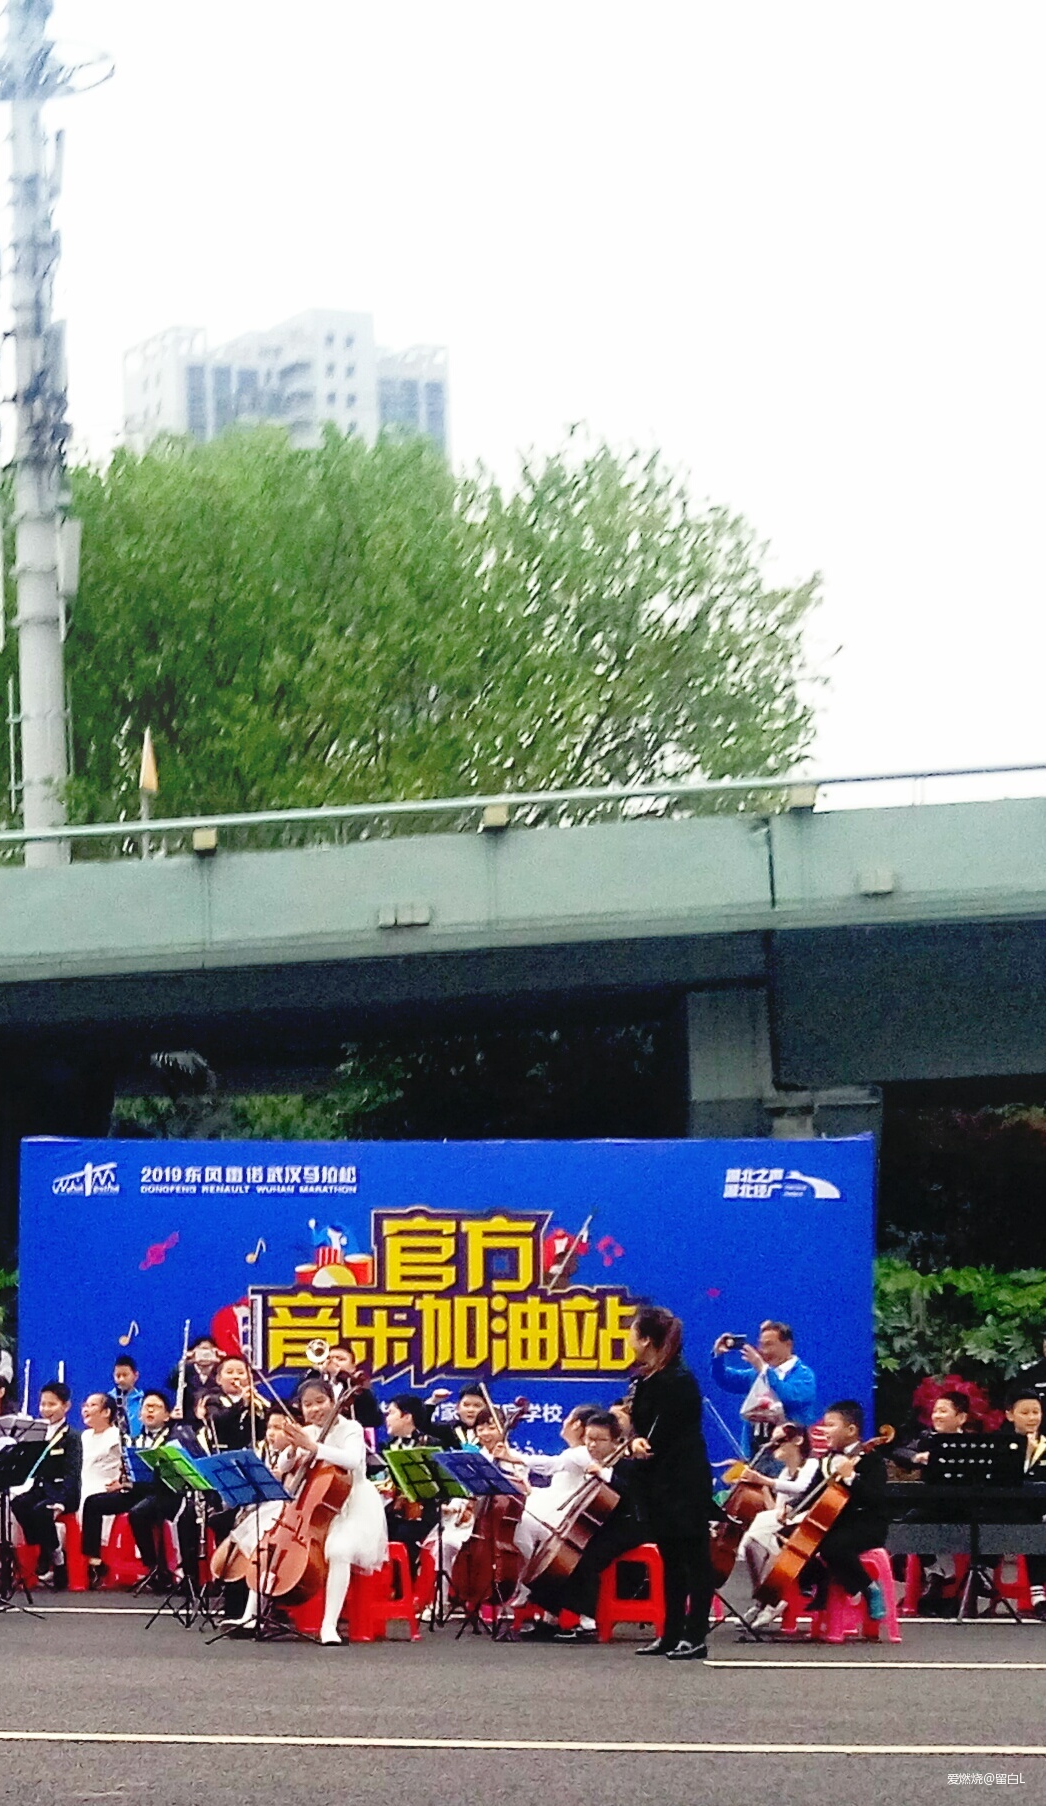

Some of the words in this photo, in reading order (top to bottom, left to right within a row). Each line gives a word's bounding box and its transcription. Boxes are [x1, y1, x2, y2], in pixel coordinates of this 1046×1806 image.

[140, 1185, 196, 1194] DONGFENG
[201, 1185, 250, 1194] RENAULT
[256, 1185, 295, 1194] WUHAN
[299, 1185, 357, 1194] MARATHON
[381, 1216, 539, 1294] 官方
[267, 1292, 639, 1375] 音乐加油站
